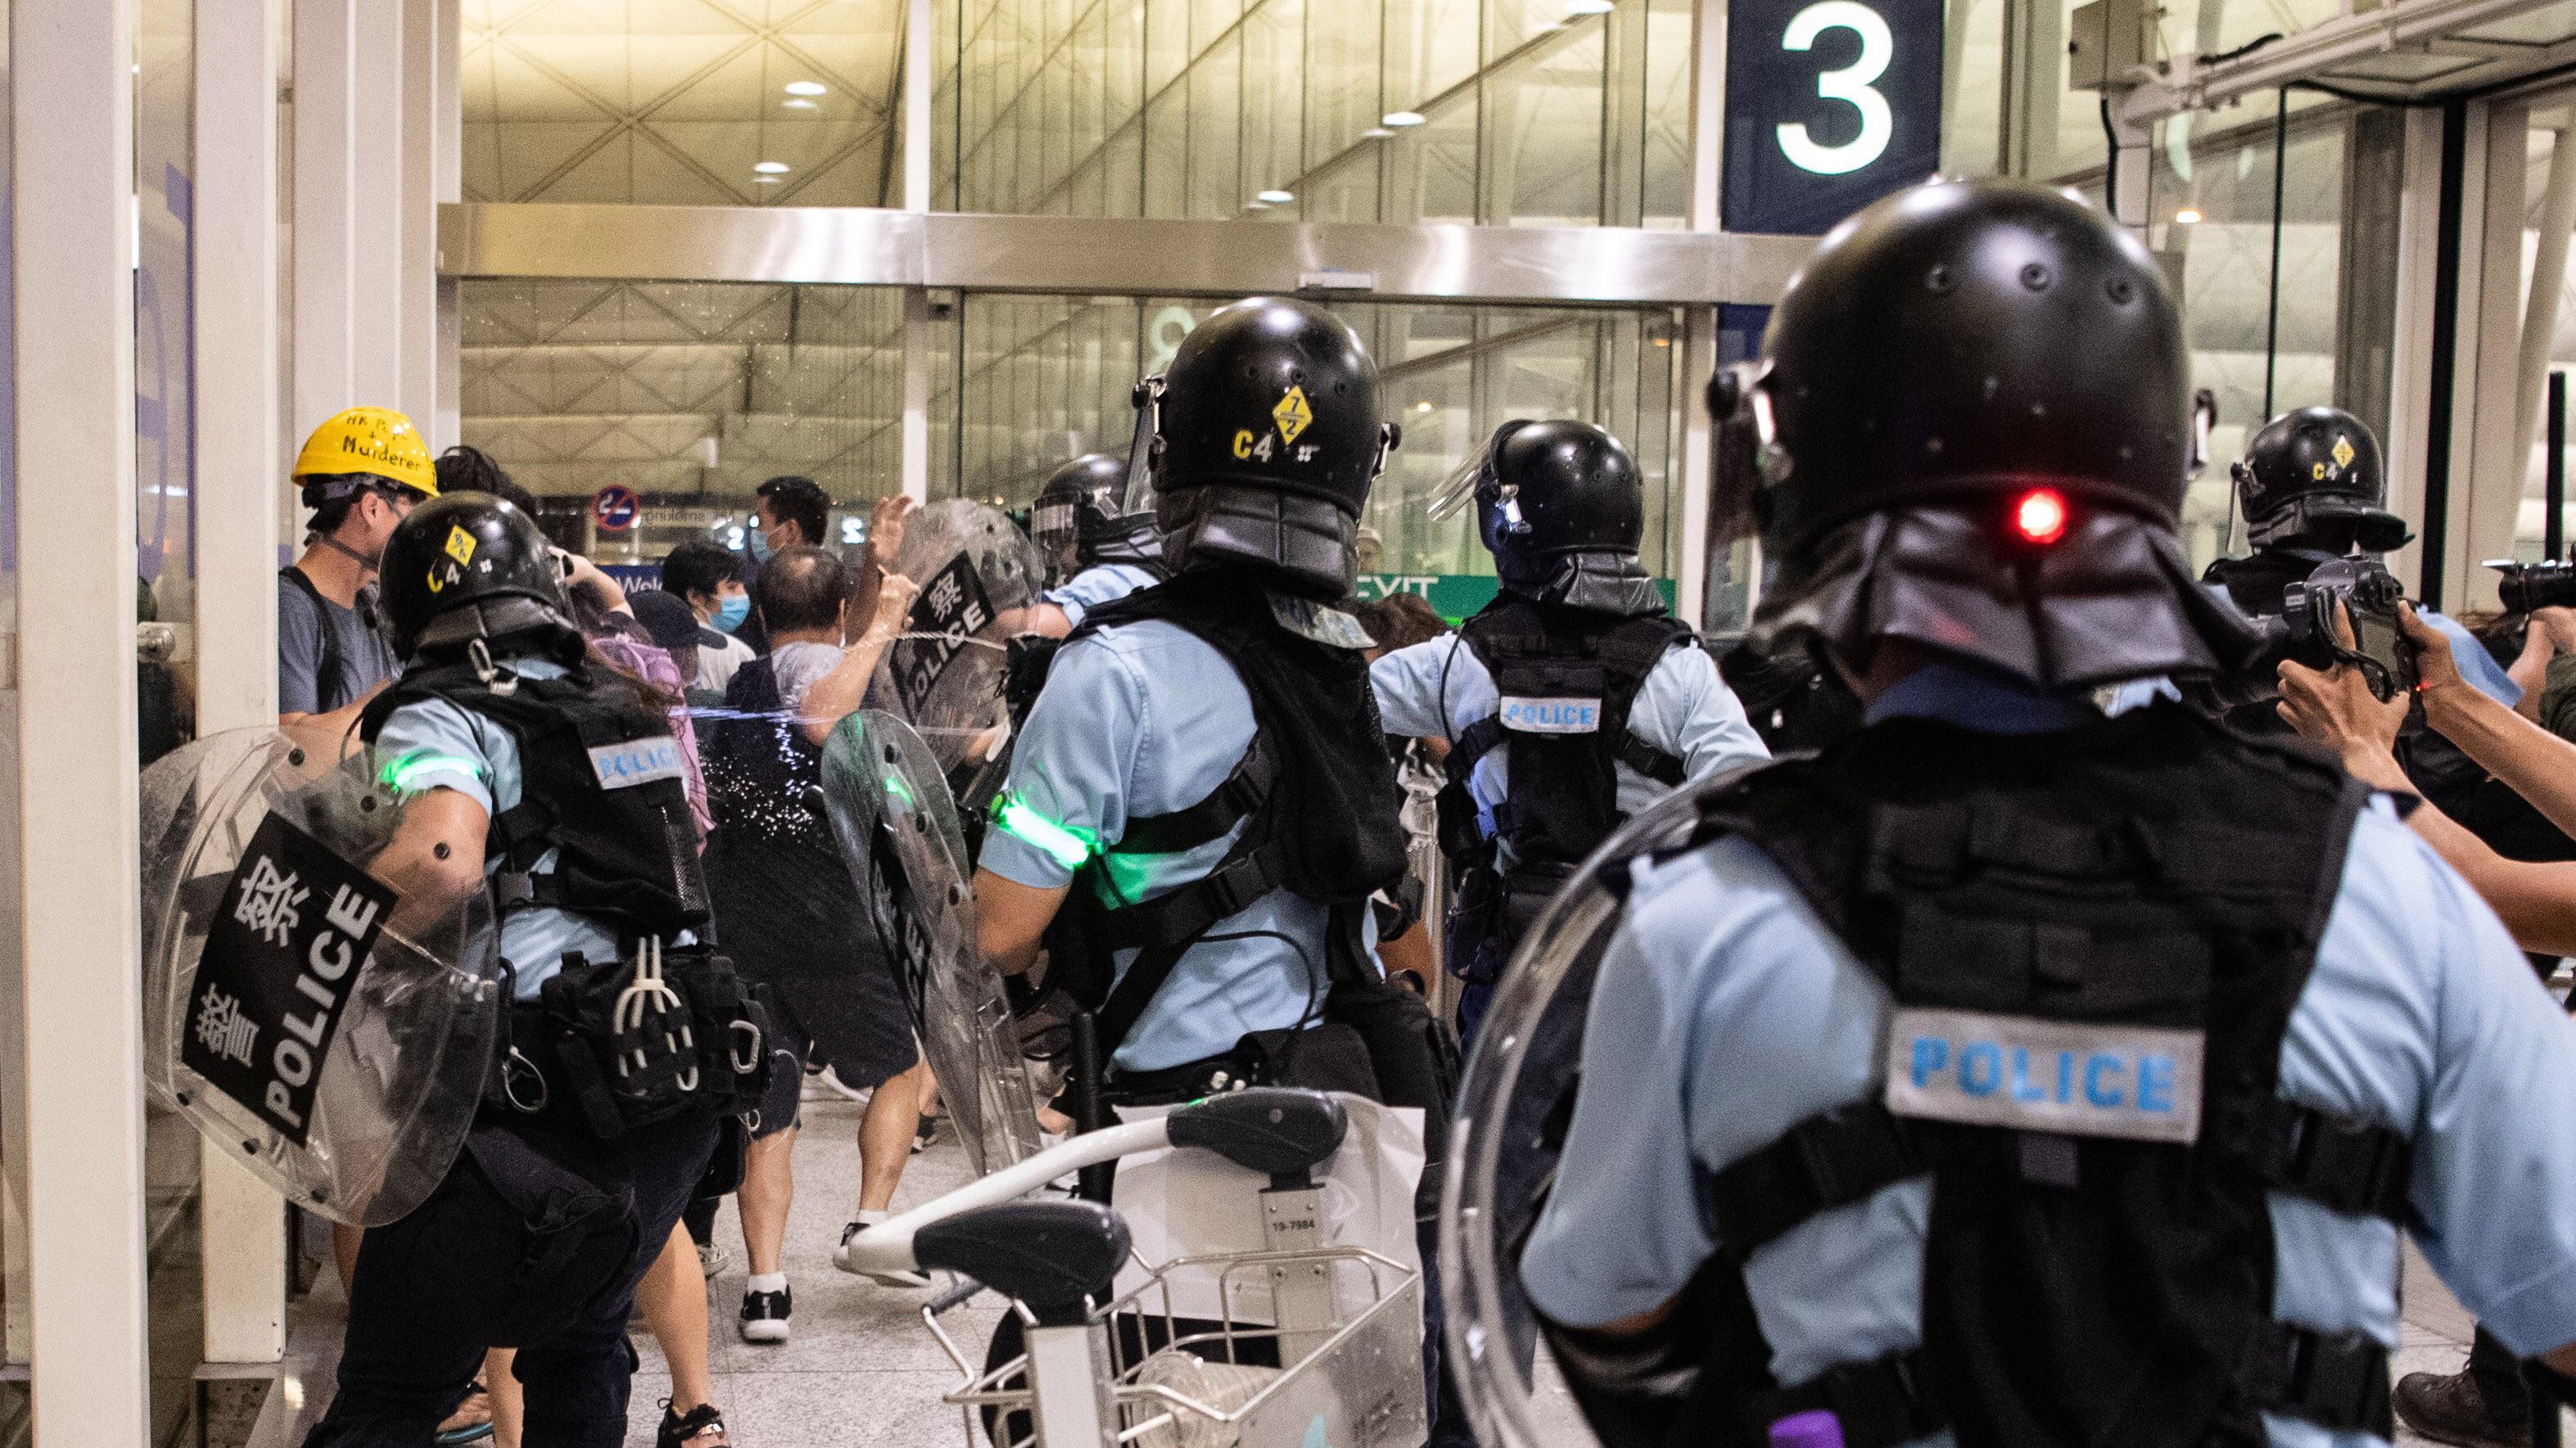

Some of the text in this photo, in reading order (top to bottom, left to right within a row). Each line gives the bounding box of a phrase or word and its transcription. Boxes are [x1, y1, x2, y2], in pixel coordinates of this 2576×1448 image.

[1775, 0, 1893, 175] 3
[1290, 396, 1301, 412] 7
[342, 435, 422, 471] Murderer
[1233, 428, 1274, 462] C4
[2313, 461, 2339, 481] C4
[1505, 704, 1595, 725] POLICE
[265, 883, 380, 1129] POLICE
[1910, 1035, 2175, 1112] POLICE
